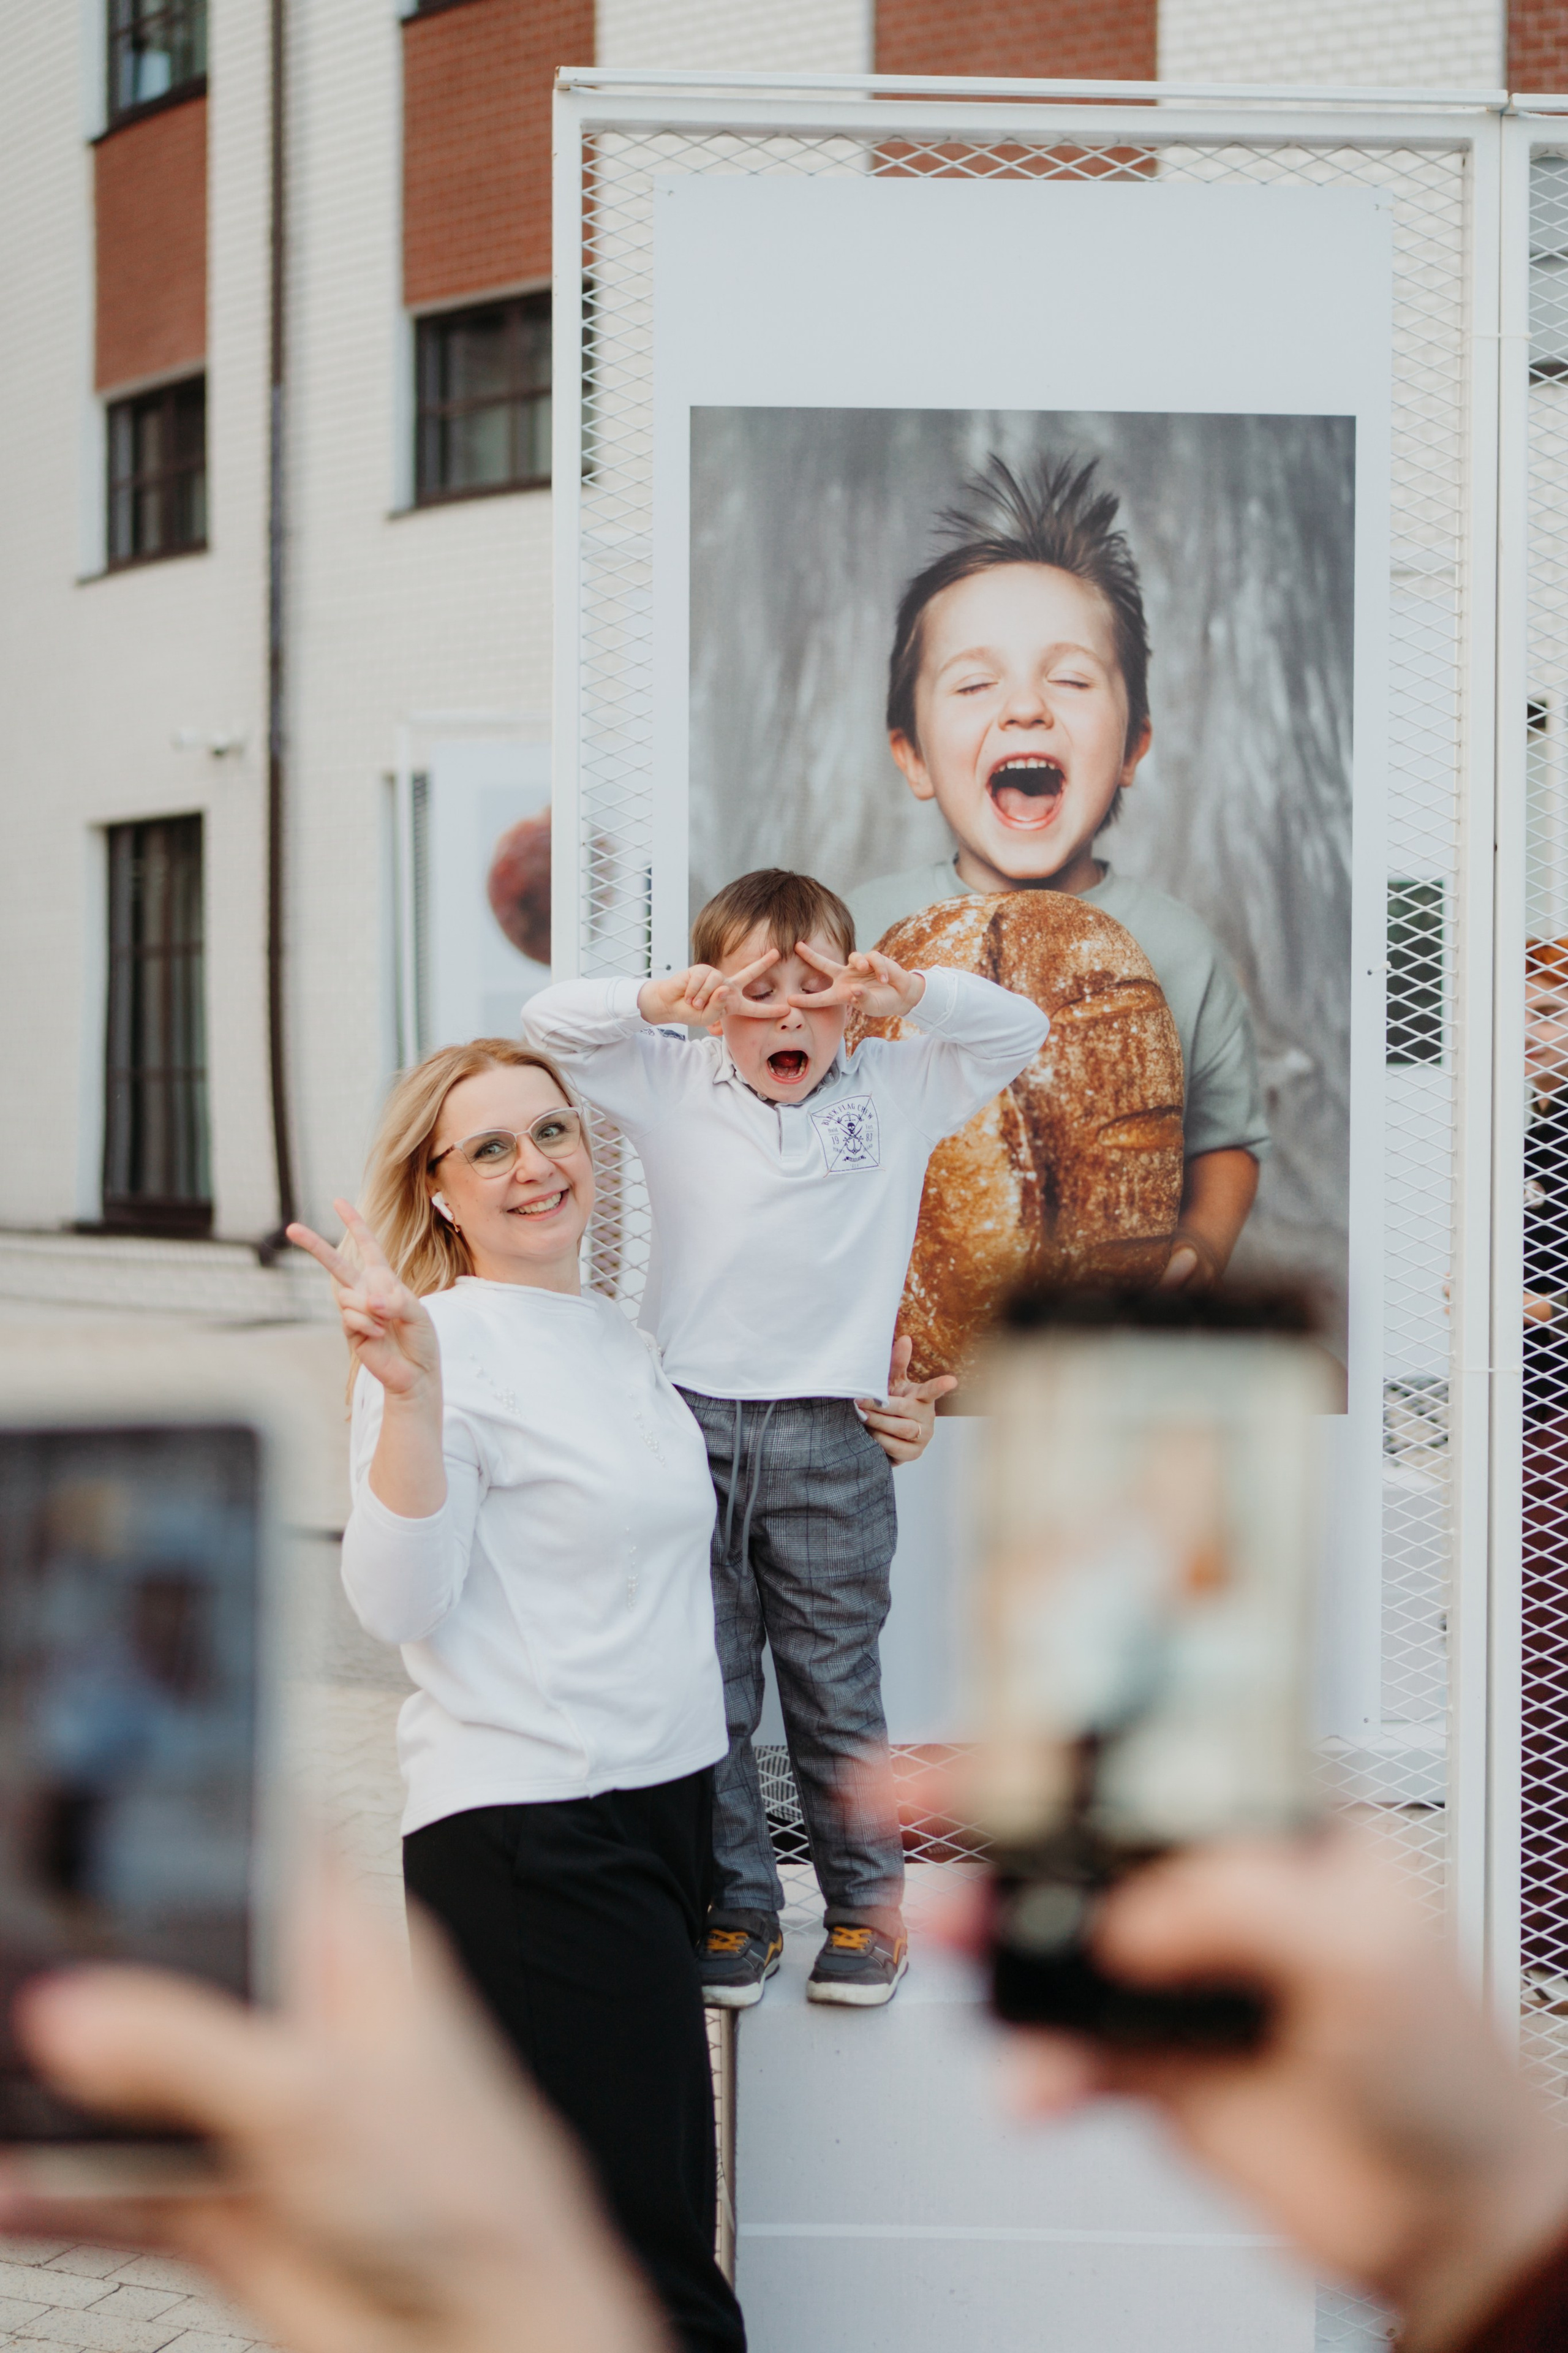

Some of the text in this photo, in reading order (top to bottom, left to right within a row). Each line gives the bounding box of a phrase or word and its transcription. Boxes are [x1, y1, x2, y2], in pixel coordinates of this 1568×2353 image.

[821, 1103, 873, 1125] BLACK FLAG CREW
[832, 1133, 872, 1144] 19 83
